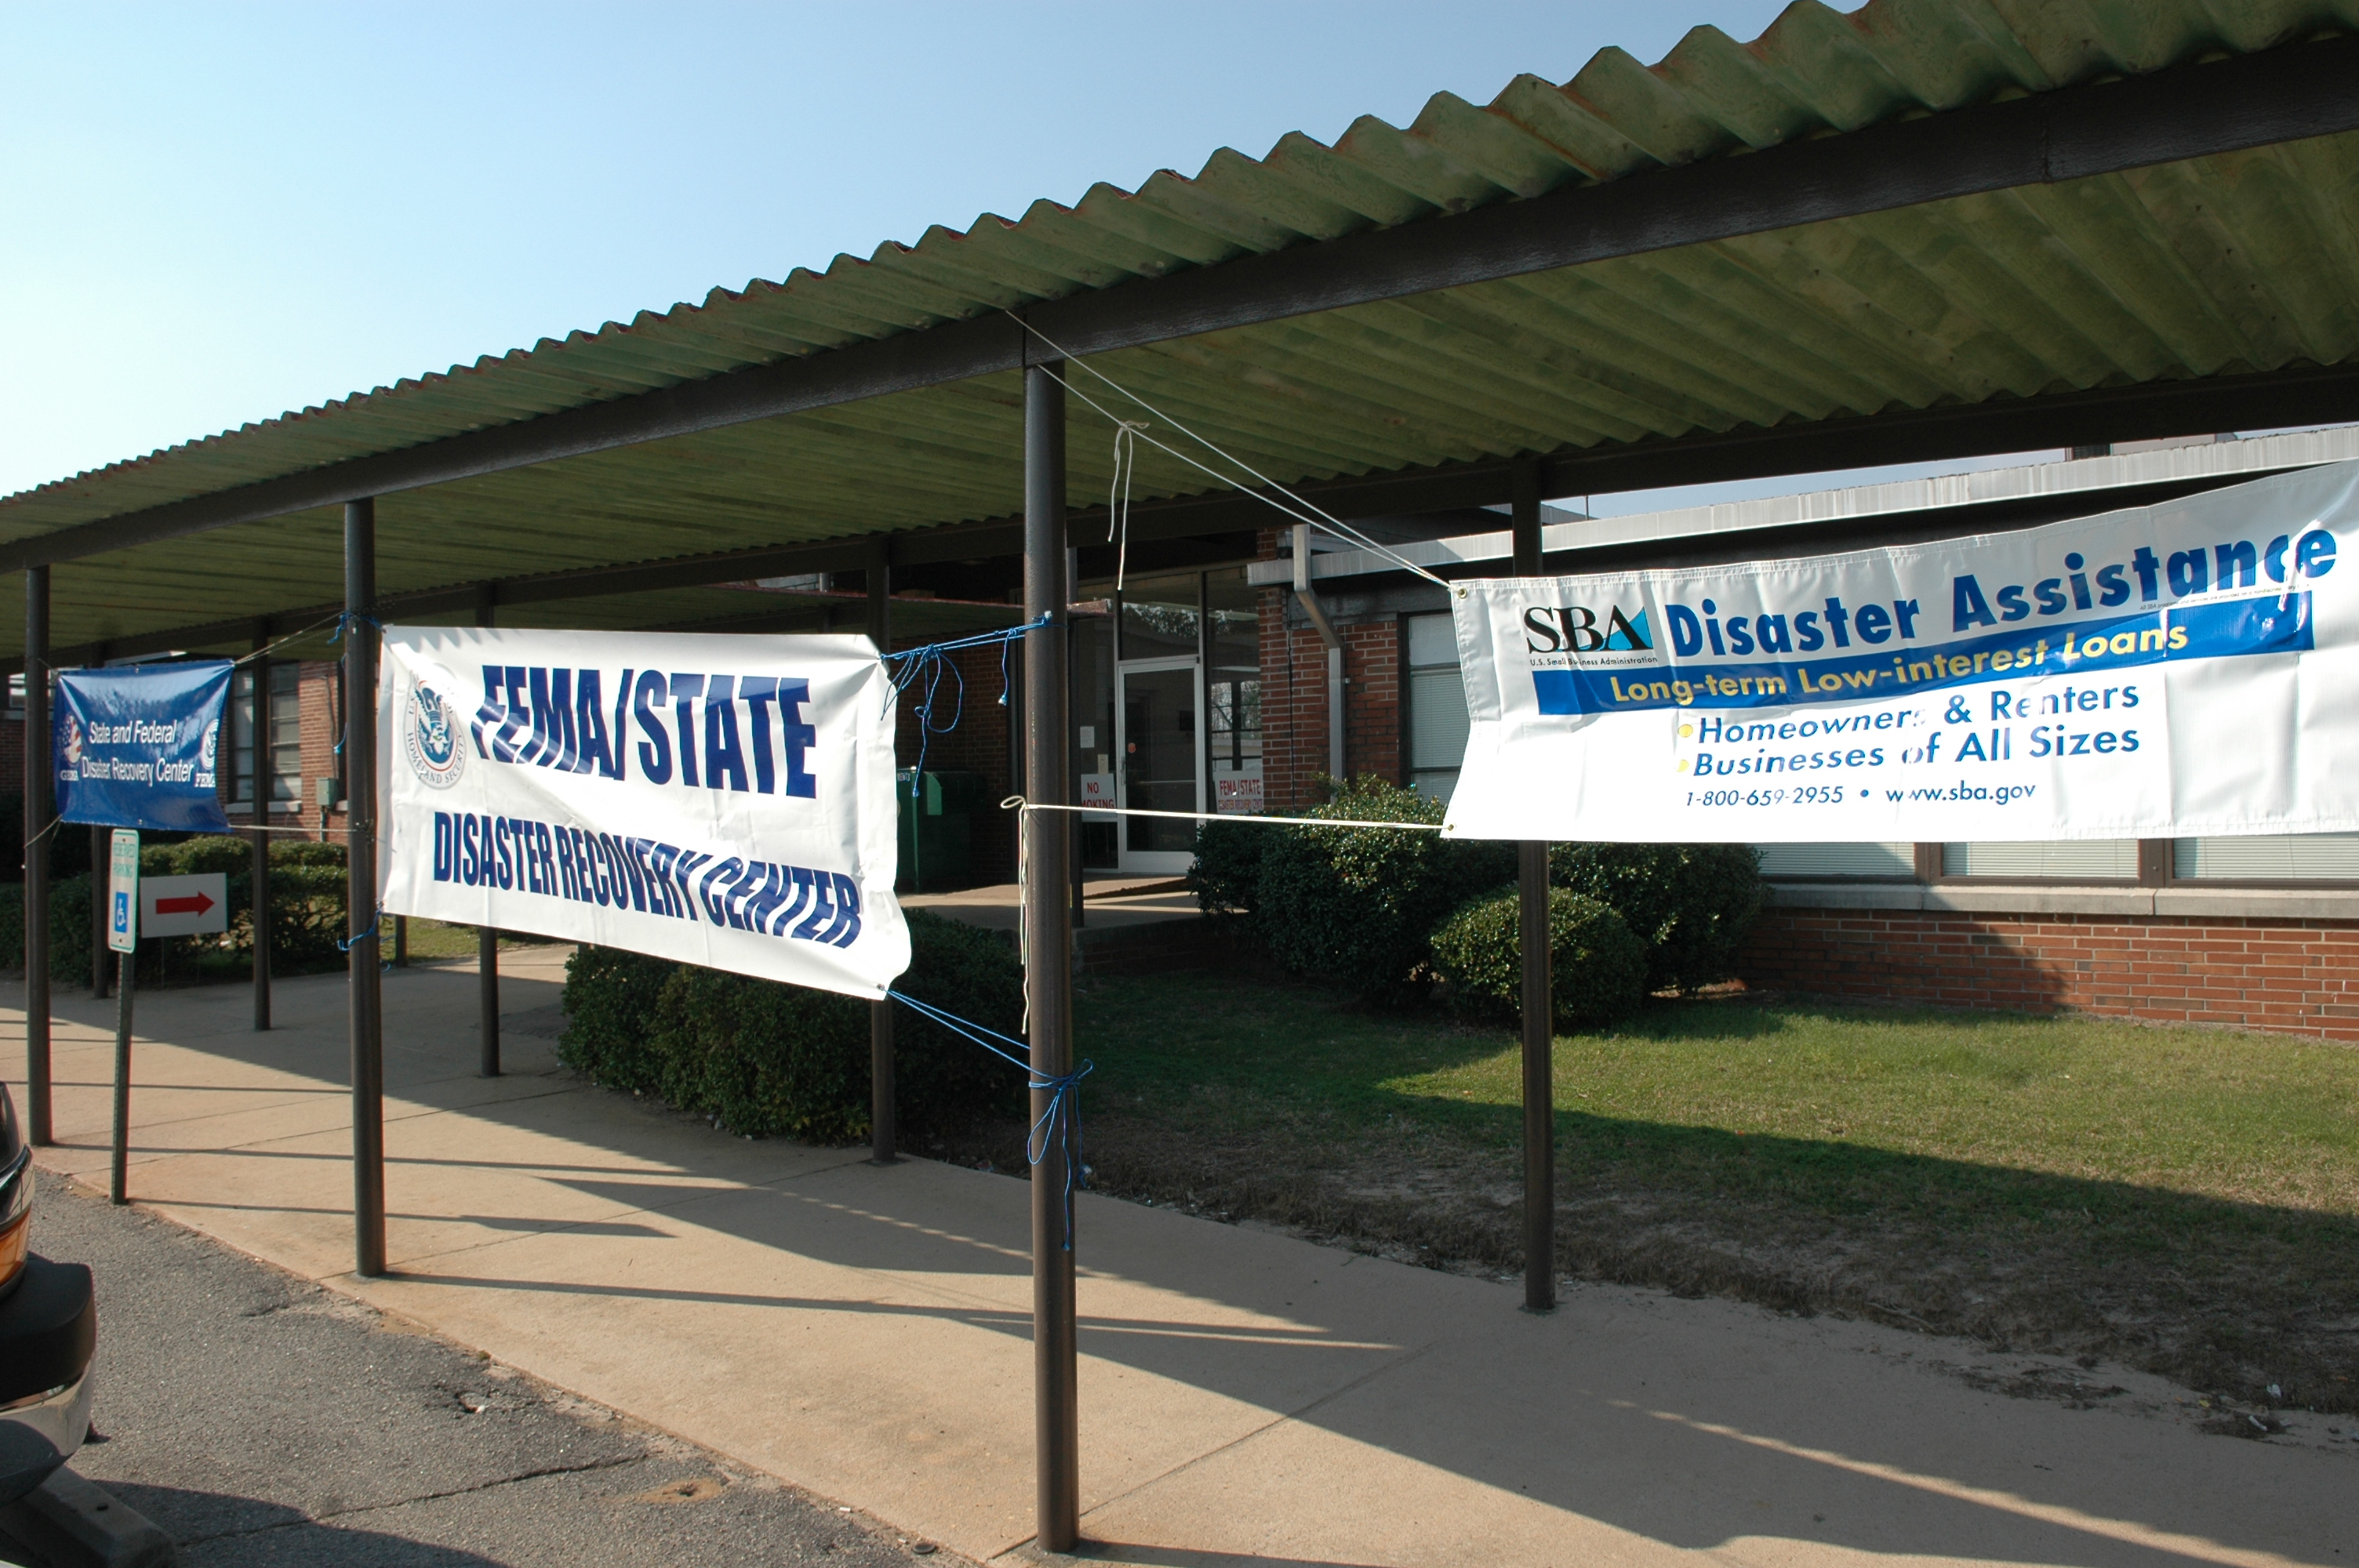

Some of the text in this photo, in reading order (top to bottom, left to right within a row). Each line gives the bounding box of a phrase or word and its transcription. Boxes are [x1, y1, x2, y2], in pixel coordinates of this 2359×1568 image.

[1664, 529, 2337, 658] Disaster Assistance
[1523, 604, 1653, 655] SBA
[1601, 655, 1658, 666] Administration
[1610, 623, 2190, 706] Long-term Low-interest Loans
[89, 719, 178, 744] State and Federal
[471, 665, 816, 800] FEMA/STATE
[1698, 685, 2139, 744] Homeowners & Renters
[1693, 724, 2140, 776] Businesses of All Sizes
[82, 756, 194, 788] Disaster Recovery Center
[1087, 782, 1100, 794] NO
[1219, 779, 1261, 797] FEMA/STATE
[1082, 798, 1114, 809] MOKING
[1687, 786, 1844, 806] 1-800-659-2955
[433, 811, 864, 949] DISASTER RECOVERY CENTER
